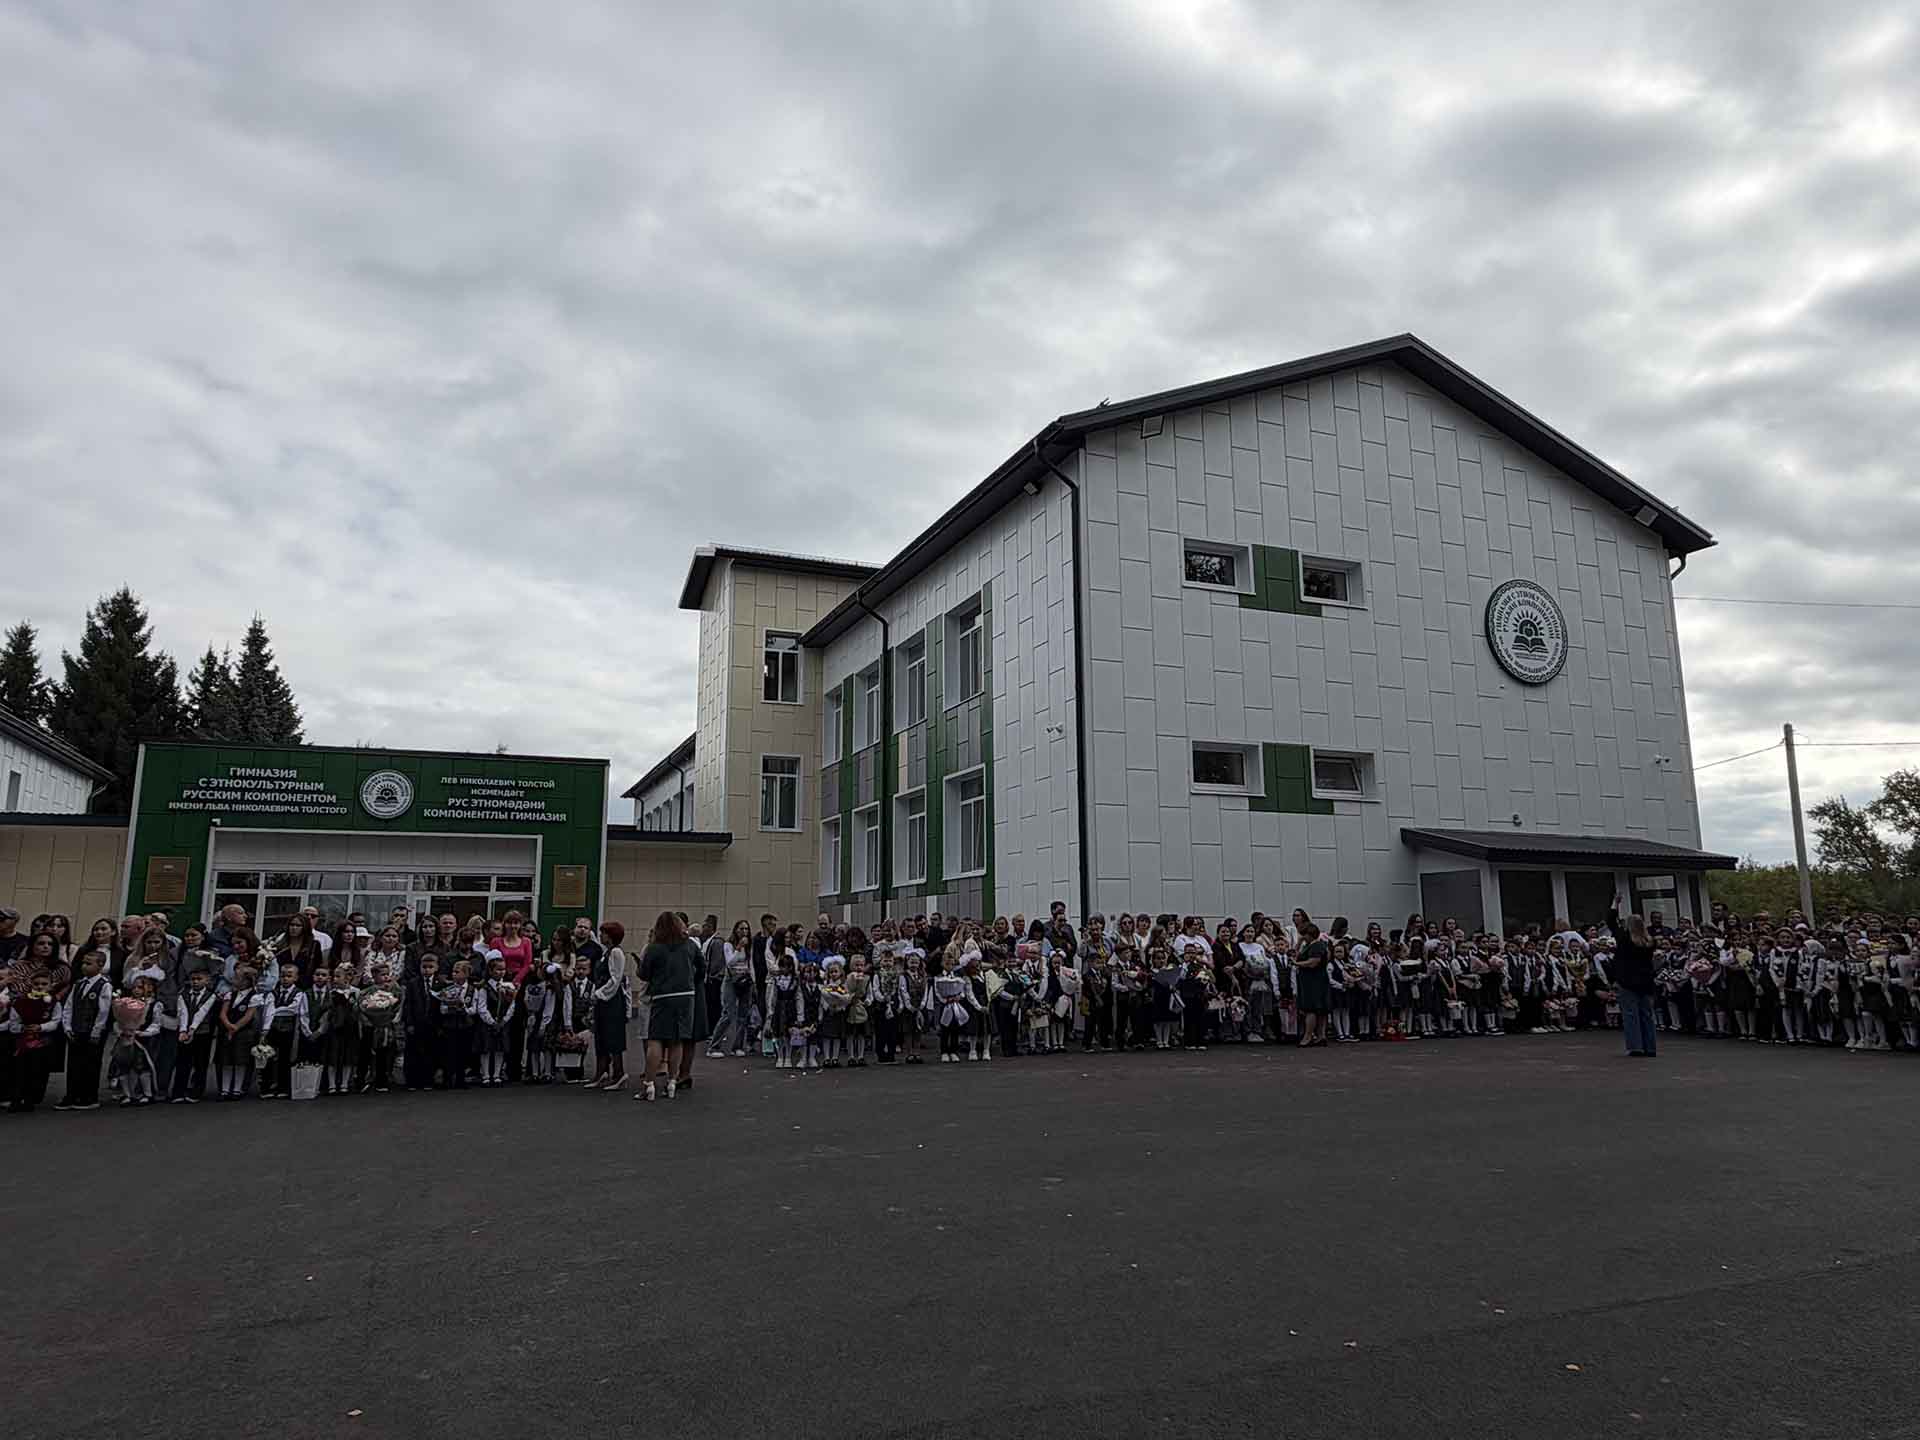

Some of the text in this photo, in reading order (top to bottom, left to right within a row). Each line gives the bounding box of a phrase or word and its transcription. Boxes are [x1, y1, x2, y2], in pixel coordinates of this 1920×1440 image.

[229, 767, 297, 778] ГИМНАЗИЯ
[198, 778, 324, 791] С ЭТНОКУЛЬТУРНЫМ
[440, 776, 555, 789] ЛЕВ НИКОЛАЕВИЧ ТОЛСТОЙ
[182, 790, 337, 804] РУССКИМ КОМПОНЕНТОМ
[448, 797, 469, 807] РУС
[169, 801, 347, 815] ИМЕНИ ЛЬВА НИКОЛАЕВИЧА ТОЛСТОГО
[423, 808, 567, 822] КОМПОНЕНТЛЫ ГИМНАЗИЯ
